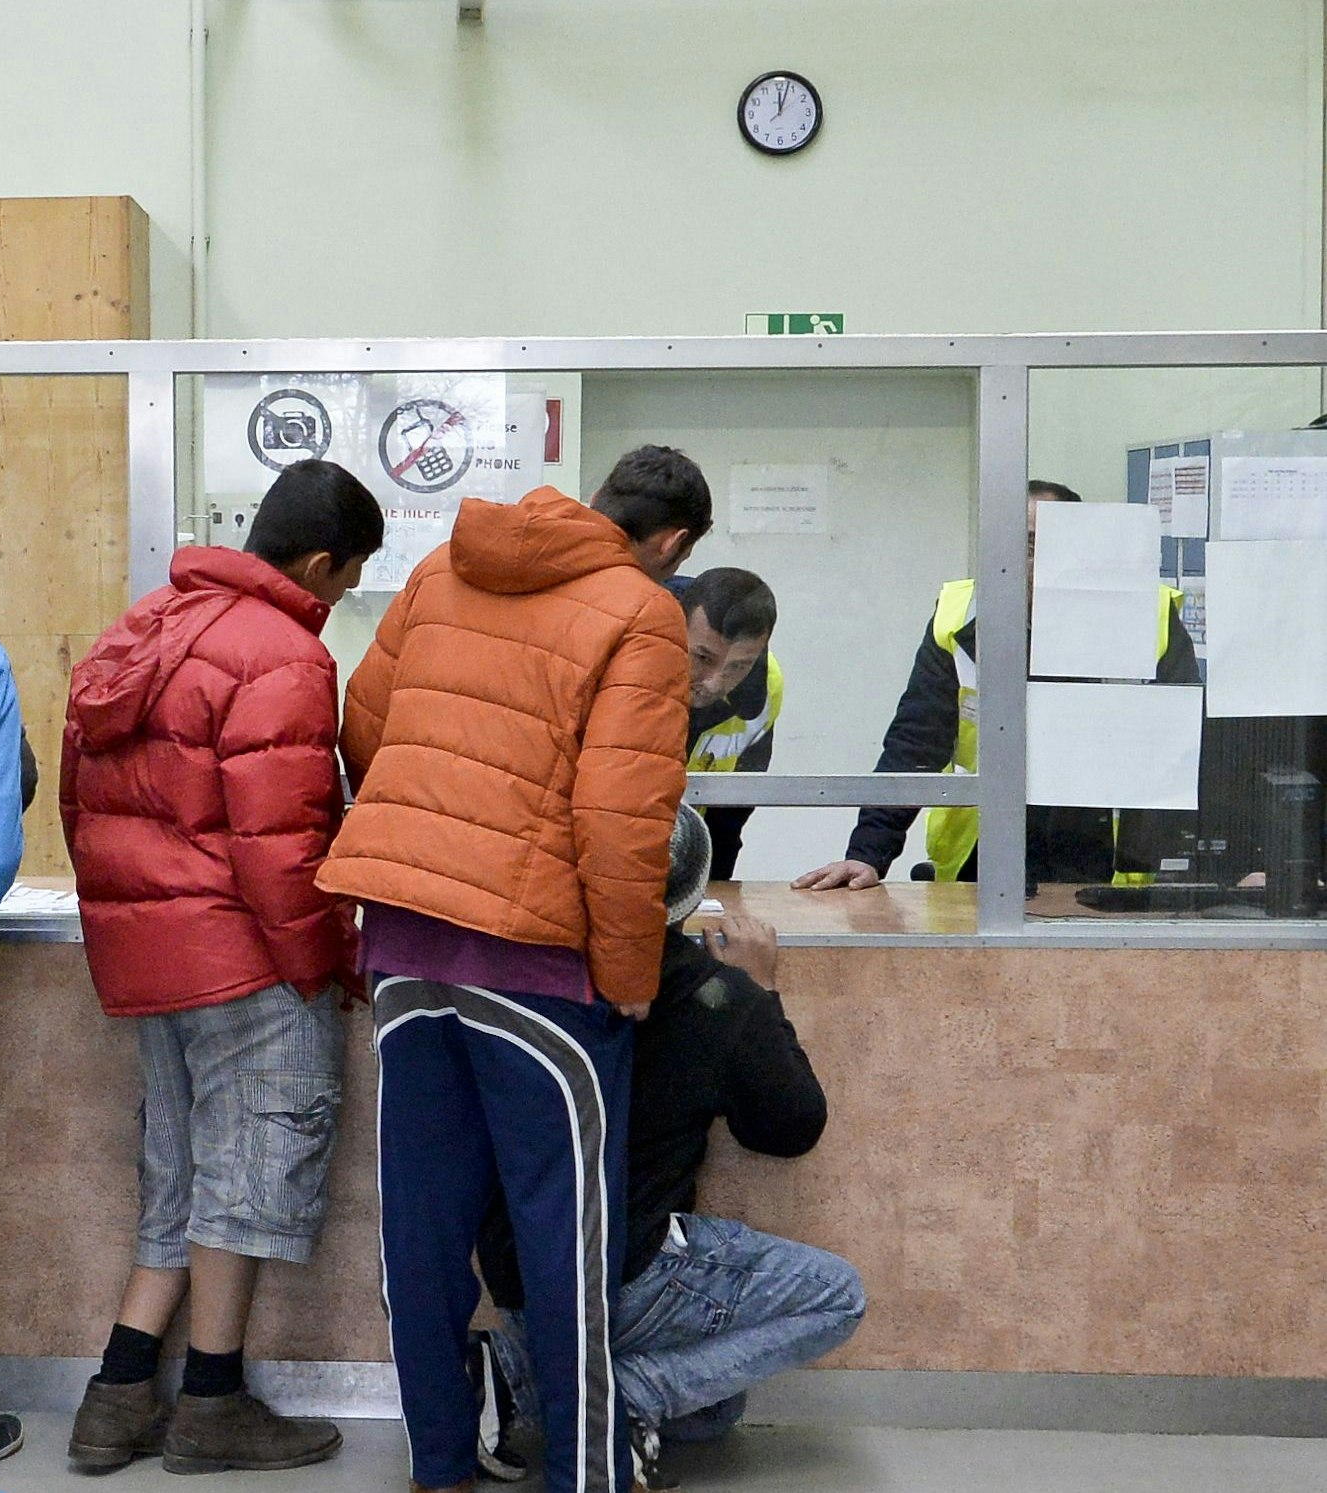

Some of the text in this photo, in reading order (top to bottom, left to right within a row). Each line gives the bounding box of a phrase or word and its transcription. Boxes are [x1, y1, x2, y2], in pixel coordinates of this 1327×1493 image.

[761, 87, 769, 95] 11
[775, 82, 784, 91] 12
[791, 85, 795, 93] 1
[752, 97, 761, 106] 10
[800, 93, 807, 103] 2
[748, 110, 755, 119] 9
[805, 107, 811, 117] 3
[753, 124, 759, 133] 8
[799, 123, 806, 131] 4
[764, 133, 770, 141] 7
[777, 136, 784, 145] 6
[791, 132, 797, 141] 5
[475, 458, 521, 470] PHONE
